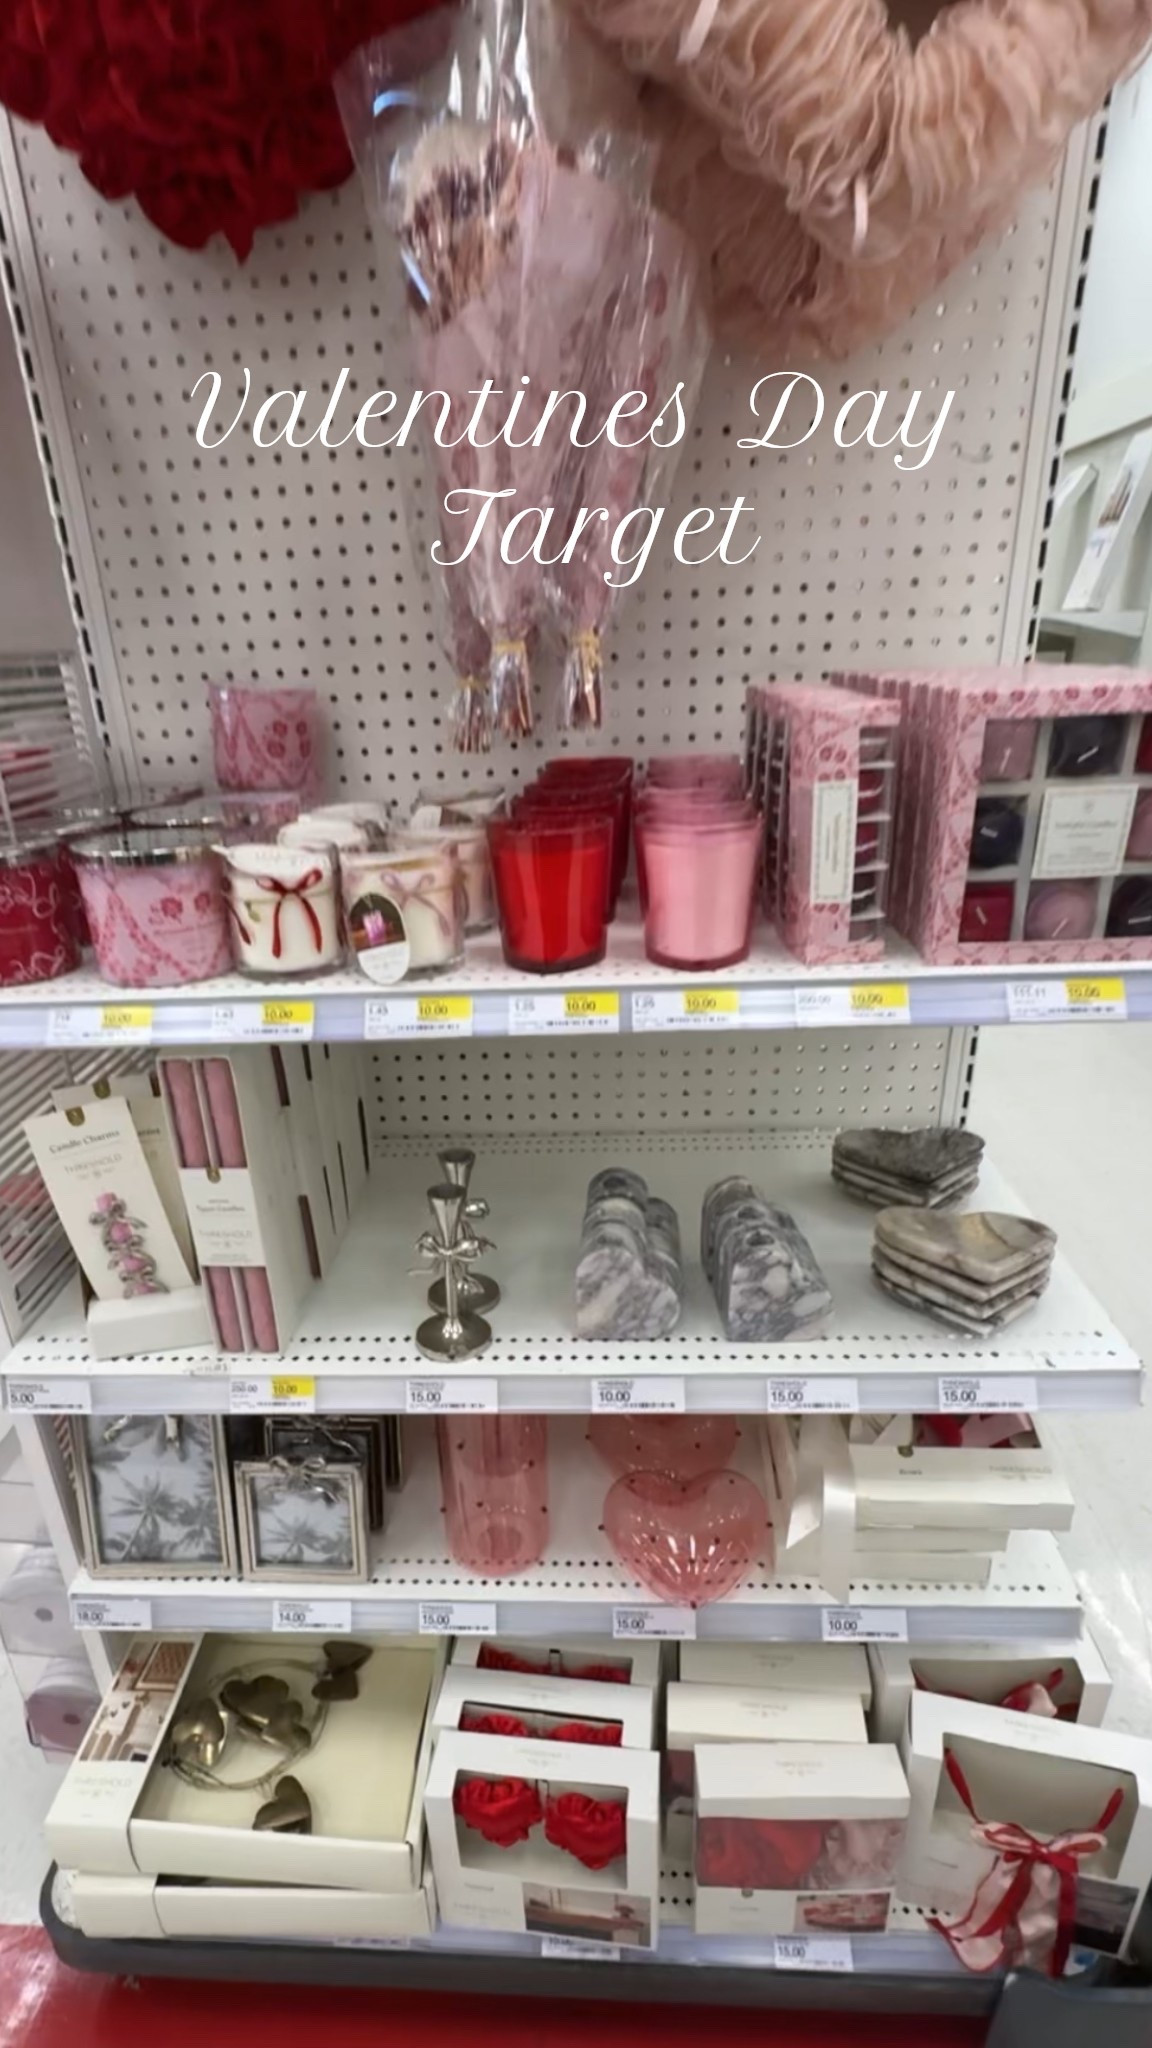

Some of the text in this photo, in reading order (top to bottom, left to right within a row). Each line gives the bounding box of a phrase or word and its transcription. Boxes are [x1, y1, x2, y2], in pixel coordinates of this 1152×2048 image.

[566, 1000, 597, 1012] 10.00
[686, 998, 717, 1010] 10.00
[419, 1004, 449, 1017] 10.00
[273, 1384, 299, 1394] 10.00
[10, 1392, 35, 1404] 5.00
[411, 1391, 441, 1403] 15.00
[599, 1390, 631, 1402] 10.00
[771, 1390, 804, 1402] 15.00
[943, 1390, 977, 1402] 15.00
[279, 1611, 306, 1623] 14.00
[423, 1613, 450, 1625] 15.00
[618, 1619, 645, 1629] 15.00
[828, 1619, 858, 1631] 10.00
